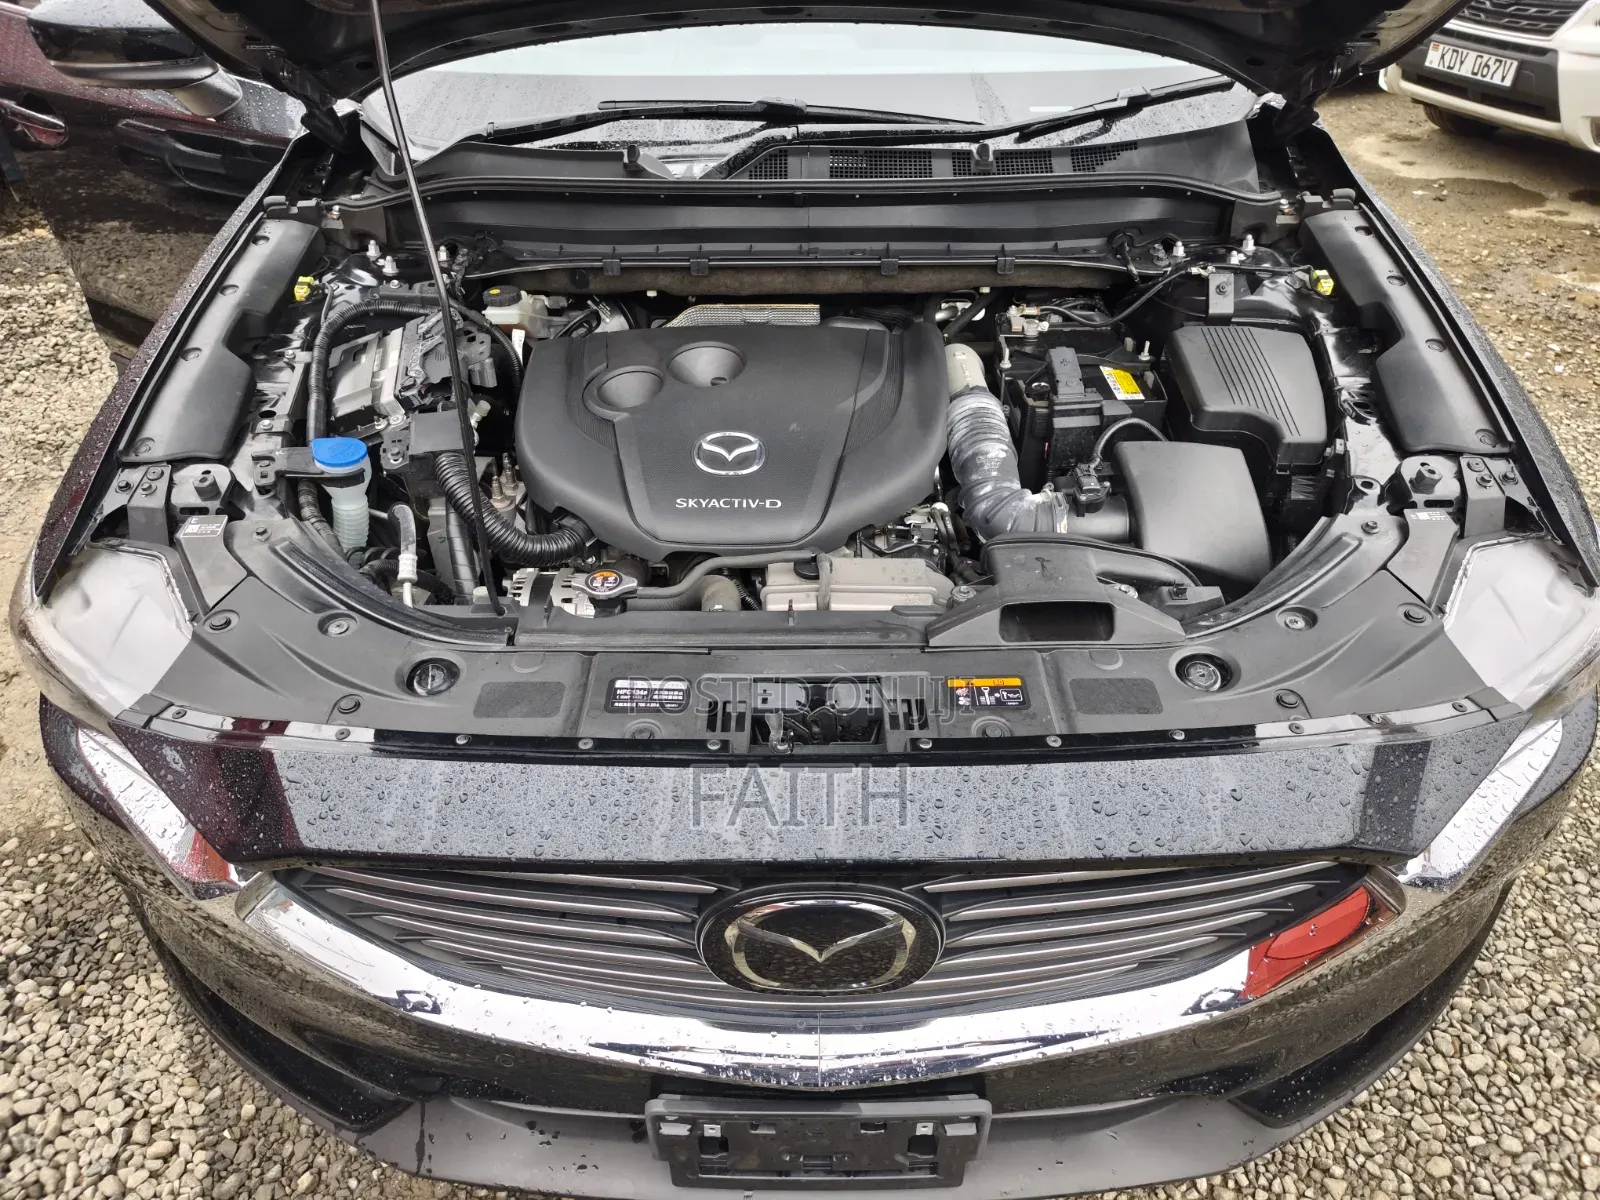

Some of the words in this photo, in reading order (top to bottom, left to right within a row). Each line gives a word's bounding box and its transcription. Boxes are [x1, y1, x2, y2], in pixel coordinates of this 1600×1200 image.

[1438, 45, 1470, 73] KDY
[1470, 54, 1514, 83] 067V
[675, 497, 782, 509] SKYACTIV-D
